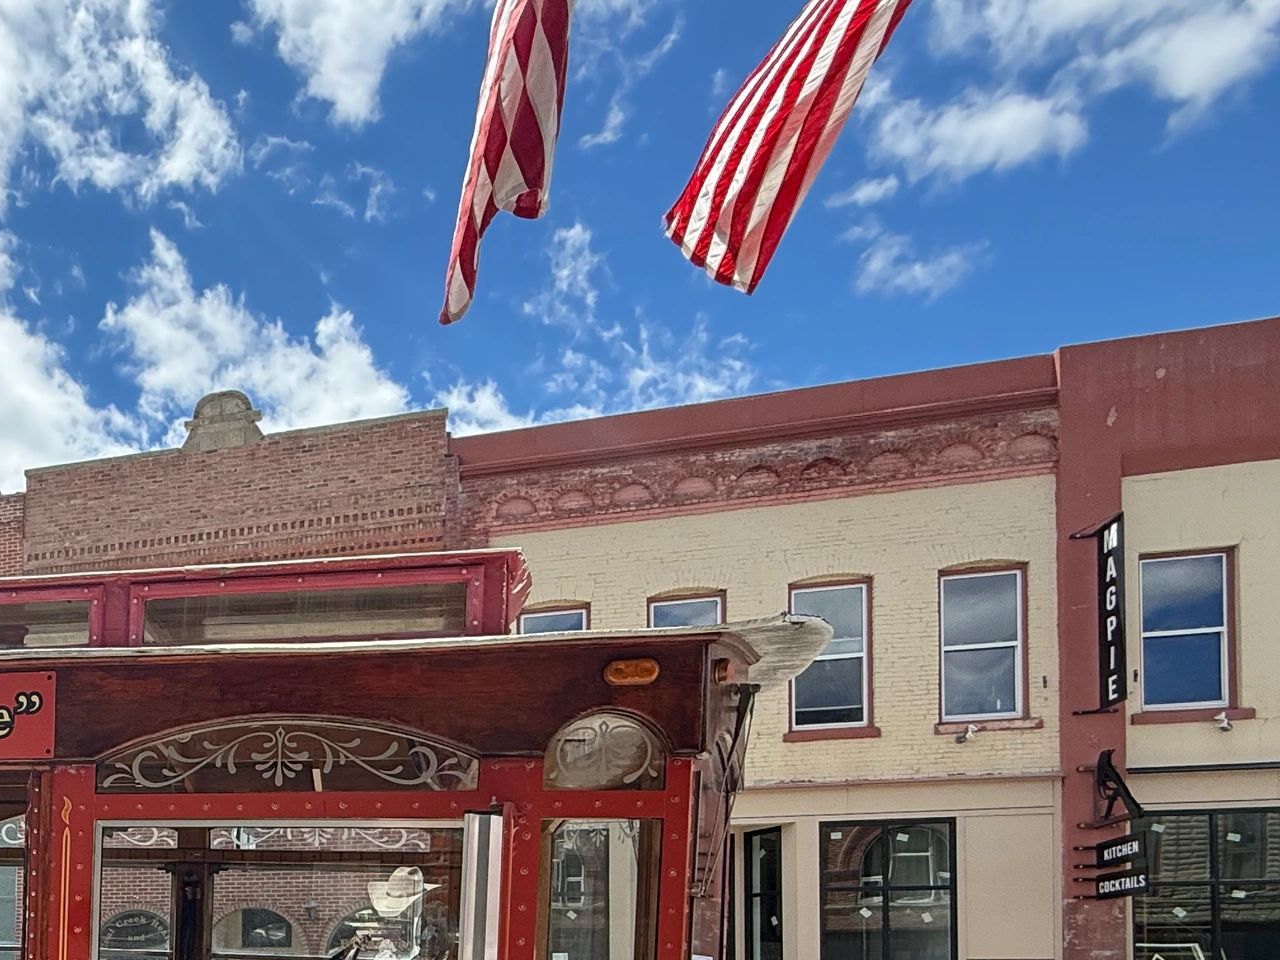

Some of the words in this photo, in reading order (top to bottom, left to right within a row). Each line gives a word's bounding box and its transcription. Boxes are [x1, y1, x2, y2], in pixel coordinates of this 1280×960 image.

[1103, 522, 1118, 700] MAGPIE
[1103, 840, 1139, 861] KITCHEN
[1098, 874, 1146, 895] COCKTAILS
